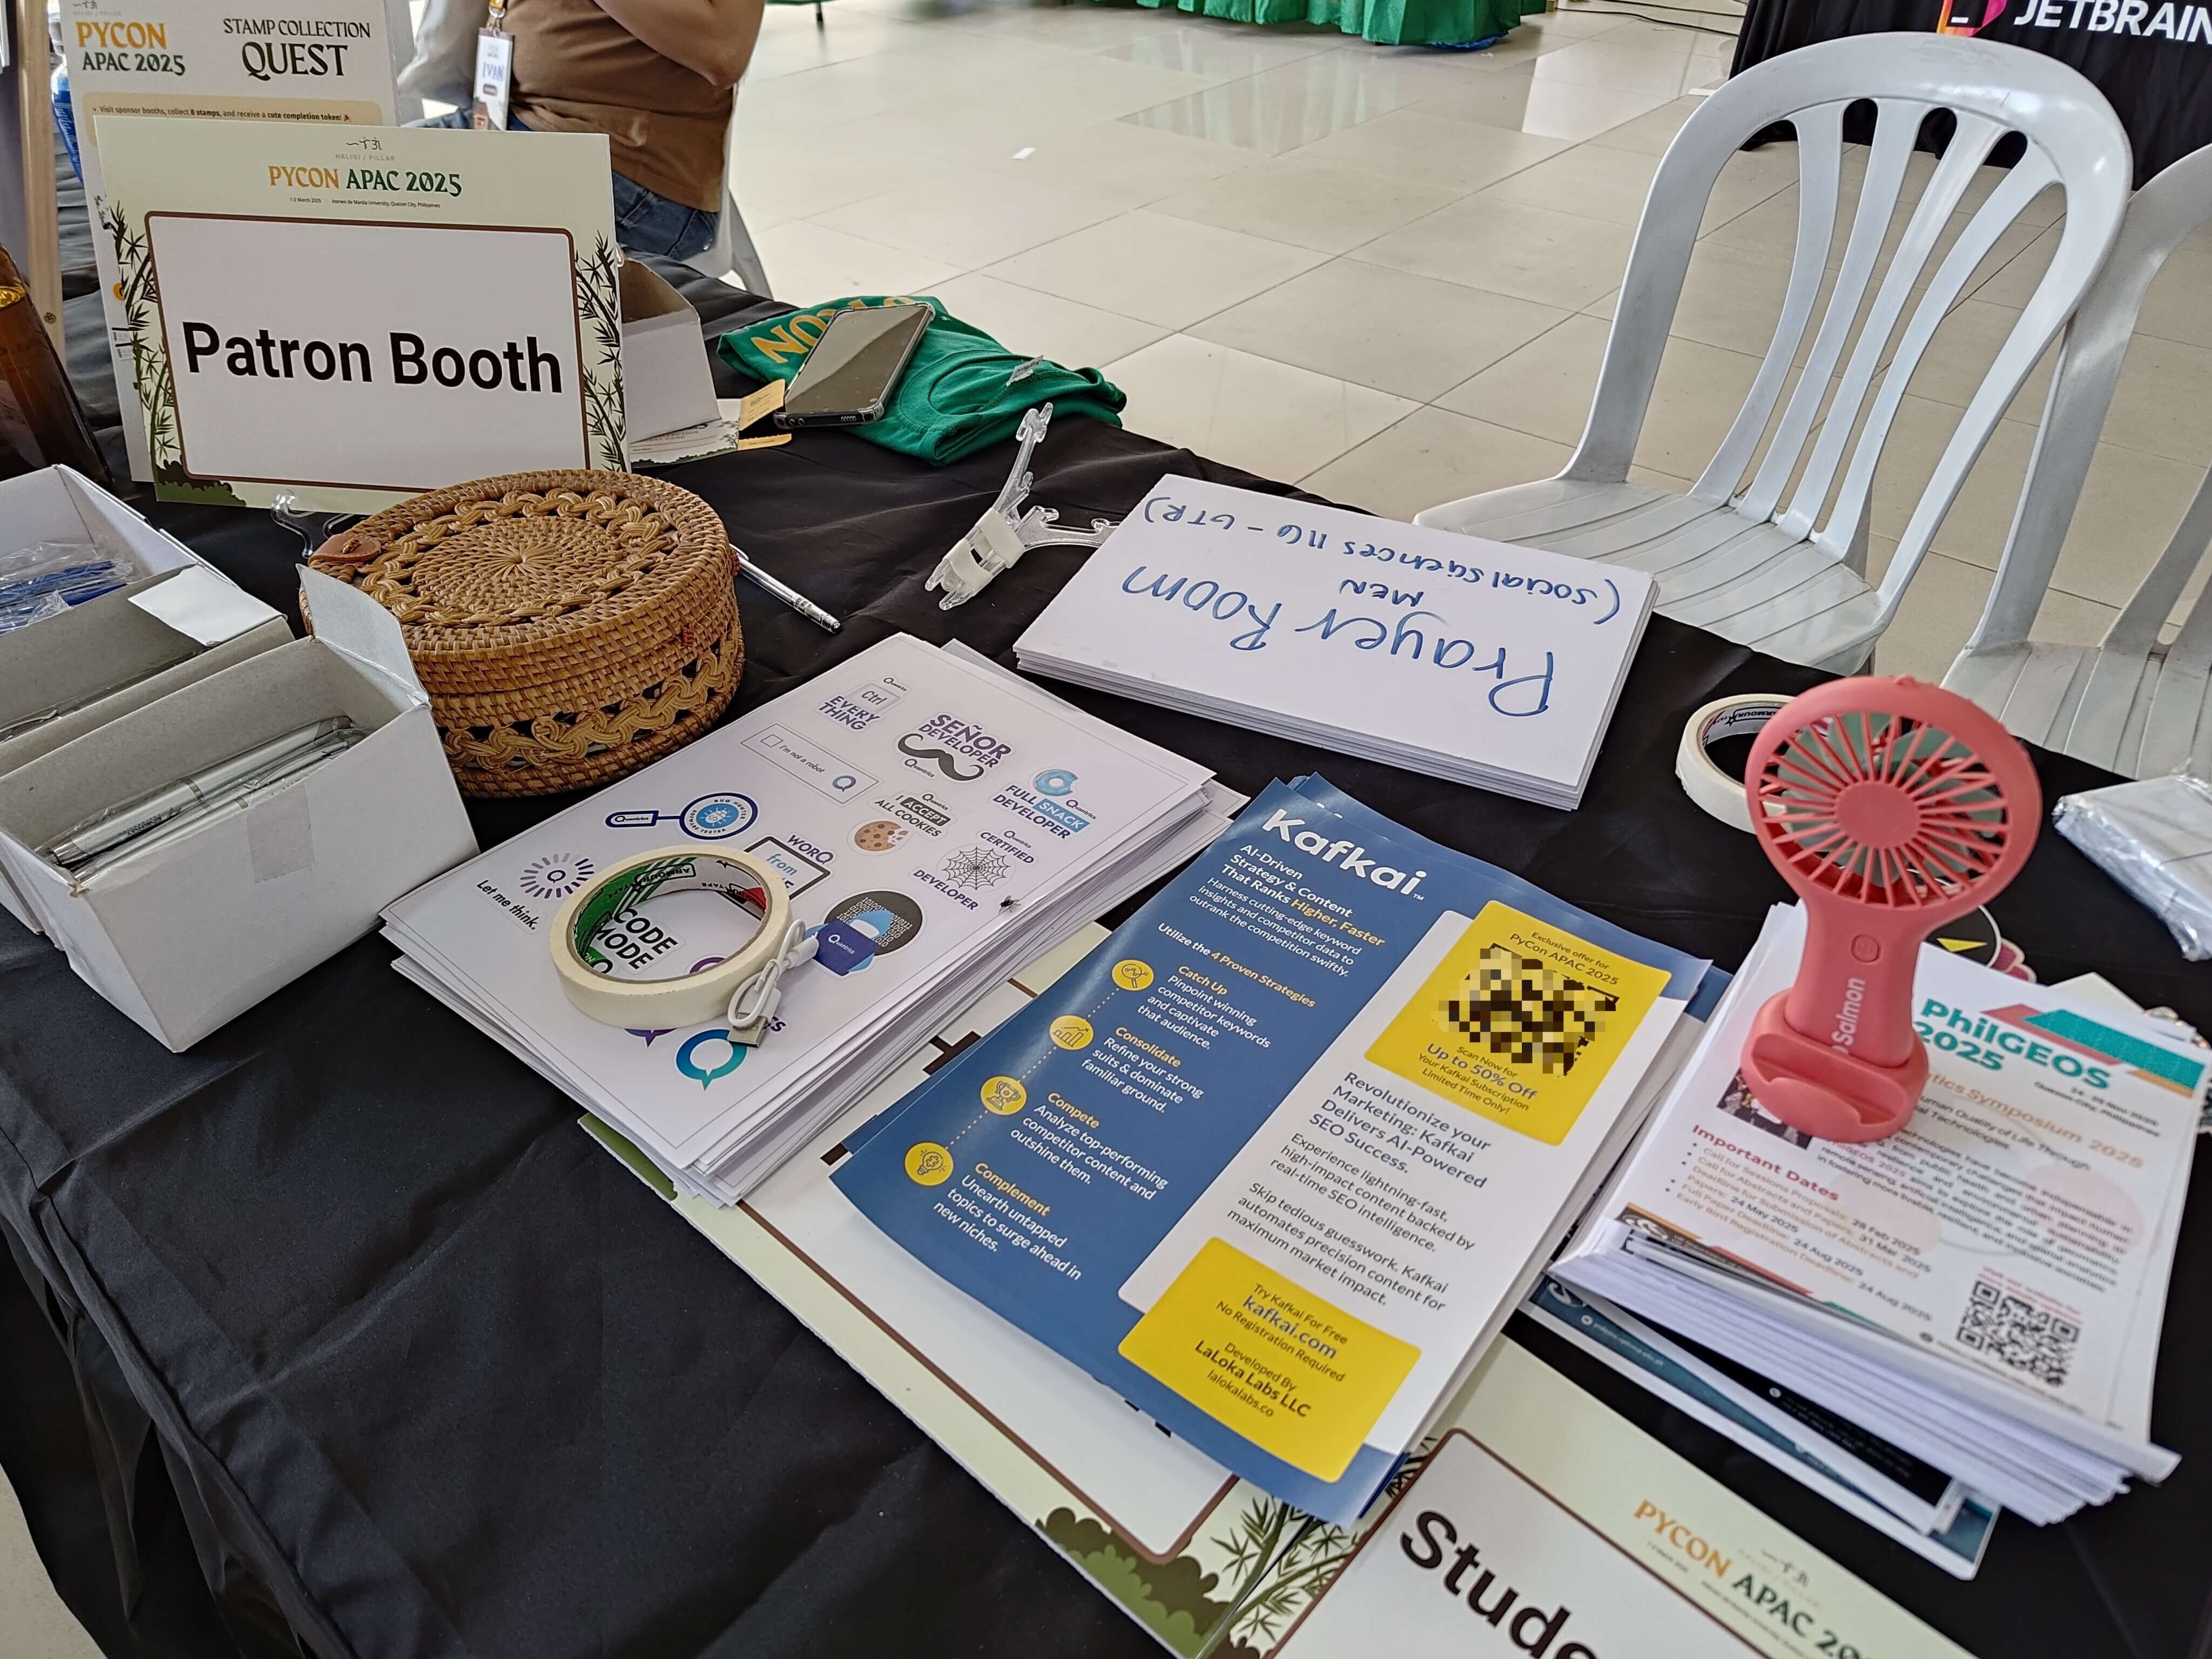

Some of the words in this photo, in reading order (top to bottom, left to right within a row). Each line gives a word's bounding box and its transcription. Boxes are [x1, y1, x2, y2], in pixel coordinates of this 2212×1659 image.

[76, 22, 167, 49] PYCON
[224, 18, 275, 35] STAMP
[279, 20, 370, 38] COLLECTION
[83, 52, 127, 71] APAC
[135, 54, 185, 76] 2025
[241, 42, 348, 81] QUEST
[268, 165, 340, 189] PYCON
[346, 169, 399, 191] APAC
[406, 171, 462, 197] 2025
[182, 321, 373, 383] Patron
[389, 332, 563, 394] Booth
[1122, 565, 1285, 652] Room
[1339, 578, 1424, 607] MEN
[883, 677, 907, 691] Quantrics
[1294, 609, 1555, 718] Prayer
[819, 702, 867, 730] THING
[828, 696, 880, 721] EVERY
[861, 690, 887, 704] Ctrl
[918, 723, 999, 767] DEVELOPER
[930, 713, 1011, 759] SEÑOR
[779, 745, 790, 753] I'm
[805, 761, 825, 772] robot
[904, 759, 934, 777] Quantrics
[614, 814, 649, 822] Quantrics
[724, 801, 754, 820] HUNTER
[874, 800, 894, 811] ALL
[893, 808, 942, 838] COOKIES
[904, 801, 946, 823] ACCEPT
[922, 794, 948, 810] Quantrics
[993, 794, 1071, 839] DEVELOPER
[1005, 785, 1036, 804] FULL
[1039, 802, 1083, 828] SNACK
[1066, 800, 1096, 819] Quantrics
[699, 822, 727, 839] TESTER
[787, 834, 833, 864] WORQ
[980, 831, 1034, 862] CERTIFIED
[1004, 831, 1031, 848] Quantrics
[1262, 808, 1426, 894] Kafkai
[766, 853, 797, 875] from
[1240, 845, 1302, 879] AI-Driven
[476, 880, 497, 894] Let
[490, 893, 512, 908] me
[509, 905, 538, 929] think.
[913, 869, 978, 909] DEVELOPER
[1222, 864, 1251, 884] That
[1250, 880, 1290, 902] Ranks
[1291, 899, 1337, 927] Higher,
[1339, 921, 1385, 945] Faster
[1230, 854, 1285, 885] Strategy
[1285, 881, 1296, 891] &
[1298, 887, 1352, 916] Content
[596, 928, 655, 970] MODE
[615, 908, 678, 955] CODE
[828, 934, 854, 953] Quantrics
[1530, 931, 1570, 953] Exclusive
[1570, 950, 1594, 962] offer
[1594, 959, 1609, 968] for
[1157, 923, 1191, 945] Utilize
[1192, 942, 1210, 955] the
[1219, 955, 1258, 979] Proven
[1258, 975, 1315, 1006] Strategies
[1179, 965, 1209, 986] Catch
[1211, 982, 1227, 994] Up
[1510, 933, 1547, 955] PyCon
[1548, 952, 1584, 970] APAC
[1585, 966, 1618, 986] 2025
[1831, 977, 1866, 1046] Salmon
[1114, 1026, 1180, 1067] Consolidate
[1918, 1021, 2007, 1074] 2025
[1921, 995, 2113, 1092] PhilGEOS
[1427, 1043, 1448, 1059] Up
[1452, 1056, 1467, 1068] to
[1470, 1062, 1508, 1085] 50%
[1508, 1082, 1537, 1099] Off
[1048, 1092, 1098, 1128] Compete
[1332, 1085, 1417, 1135] Marketing:
[1419, 1130, 1474, 1162] Kafkai
[1344, 1072, 1449, 1131] Revolutionize
[1451, 1128, 1490, 1149] your
[1953, 1107, 1997, 1133] Quality
[1995, 1125, 2012, 1138] of
[1966, 1088, 2083, 1145] Symposium
[2087, 1137, 2144, 1170] 2025
[1309, 1114, 1344, 1135] SEO
[1344, 1132, 1407, 1173] Success.
[1321, 1099, 1385, 1138] Delivers
[1386, 1135, 1487, 1188] AI-Powered
[1685, 1123, 1787, 1175] Important
[1782, 1169, 1842, 1202] Dates
[975, 1163, 1049, 1216] Complement
[1729, 1195, 1746, 1206] 24
[1743, 1202, 1771, 1221] May
[1768, 1215, 1800, 1233] 2025
[1243, 1295, 1336, 1358] kafkai.com
[1195, 1340, 1244, 1378] LaLoka
[1245, 1371, 1279, 1399] Labs
[1280, 1393, 1310, 1417] LLC
[1223, 1342, 1281, 1382] Developed
[1278, 1375, 1296, 1391] By
[1206, 1369, 1273, 1416] lalokalabs.co
[1633, 1500, 1732, 1578] PYCON
[1732, 1573, 1814, 1637] APAC
